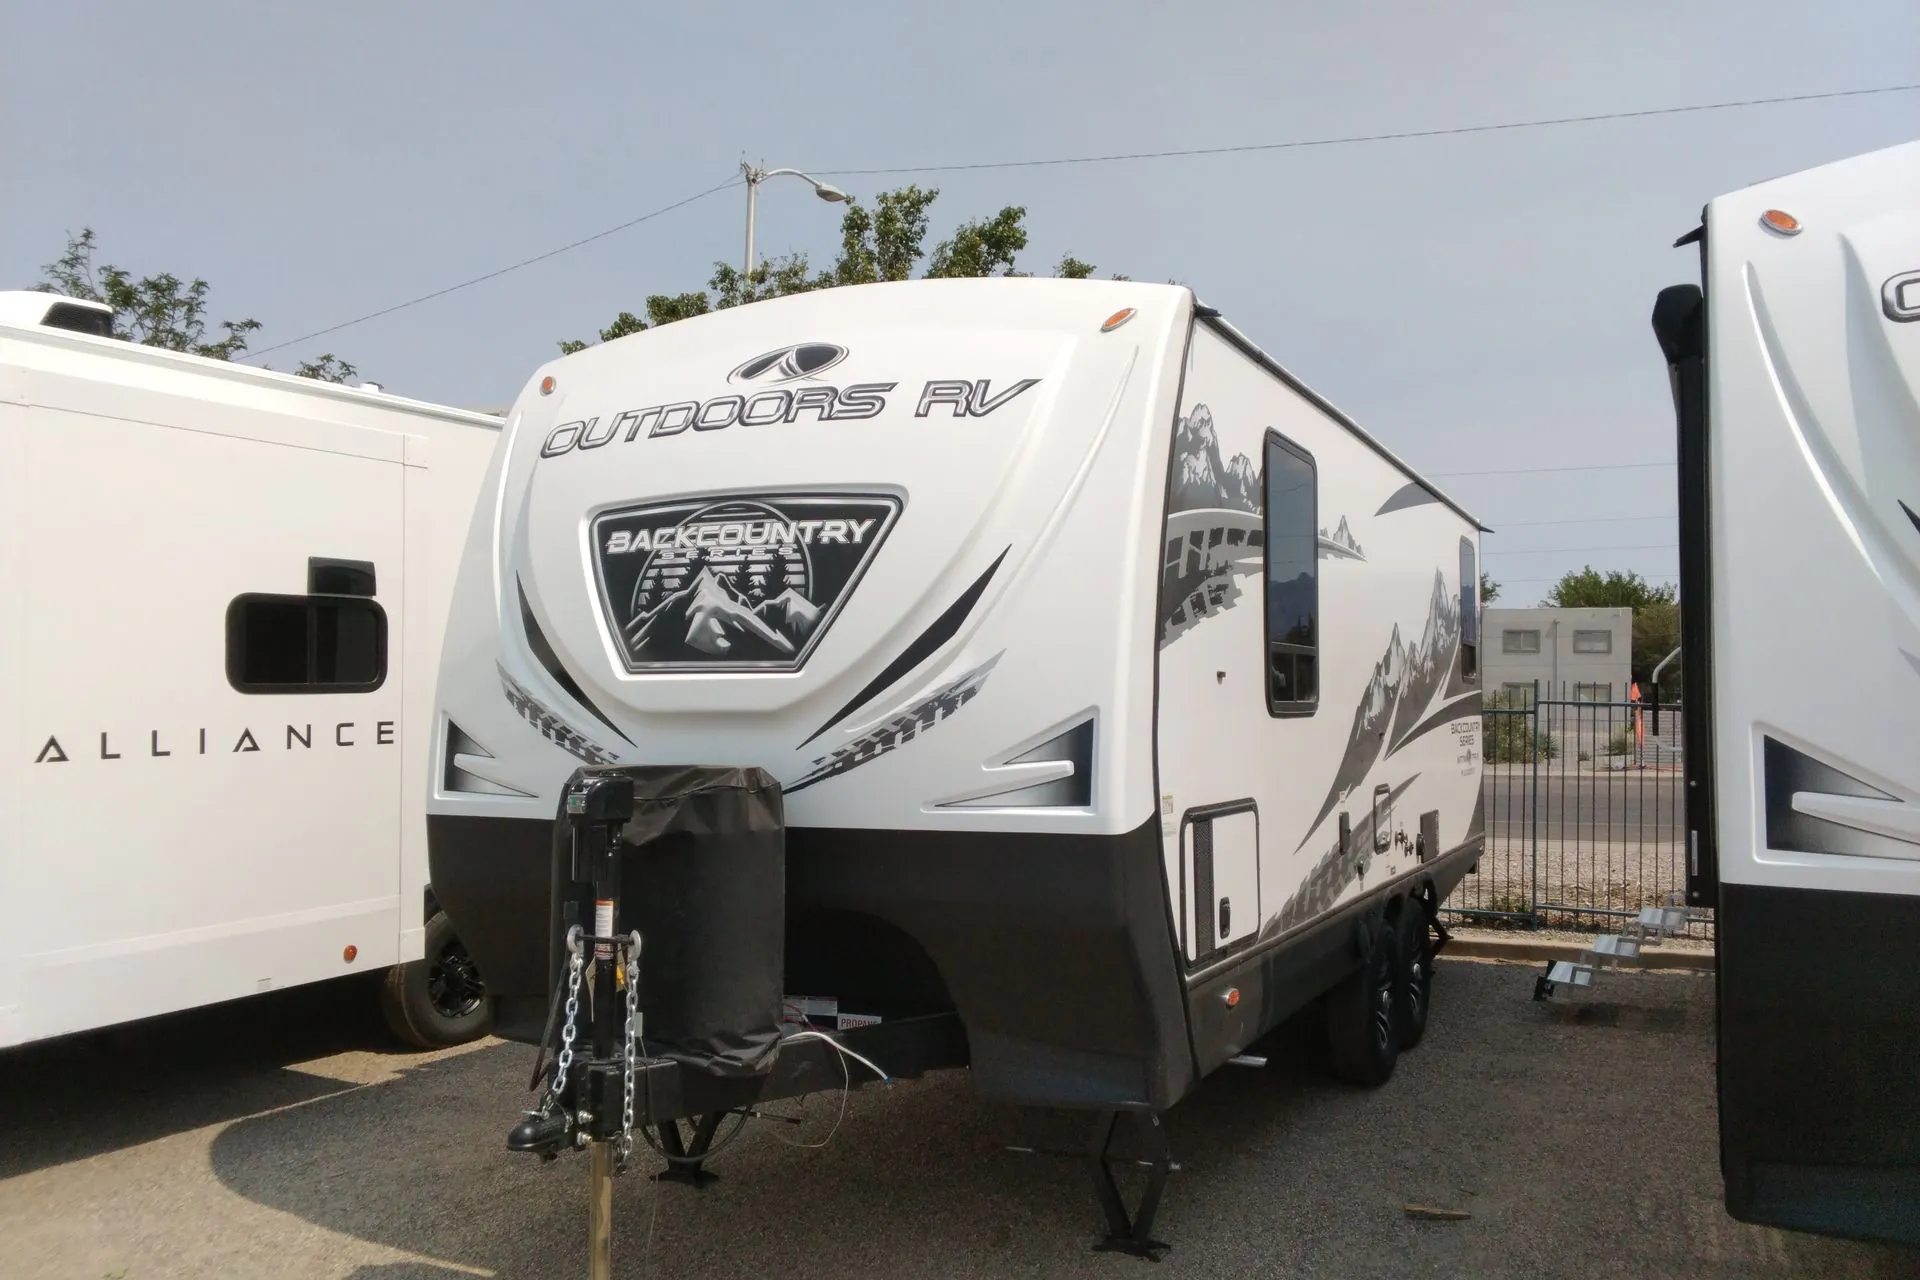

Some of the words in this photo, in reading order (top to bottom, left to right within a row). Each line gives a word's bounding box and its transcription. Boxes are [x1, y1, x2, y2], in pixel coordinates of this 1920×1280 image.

[540, 382, 899, 459] OUTDOORS
[914, 378, 1042, 418] RV
[606, 518, 876, 554] BACKCOUNTRY
[661, 546, 794, 560] SERIES
[34, 721, 394, 763] ALLIANCE
